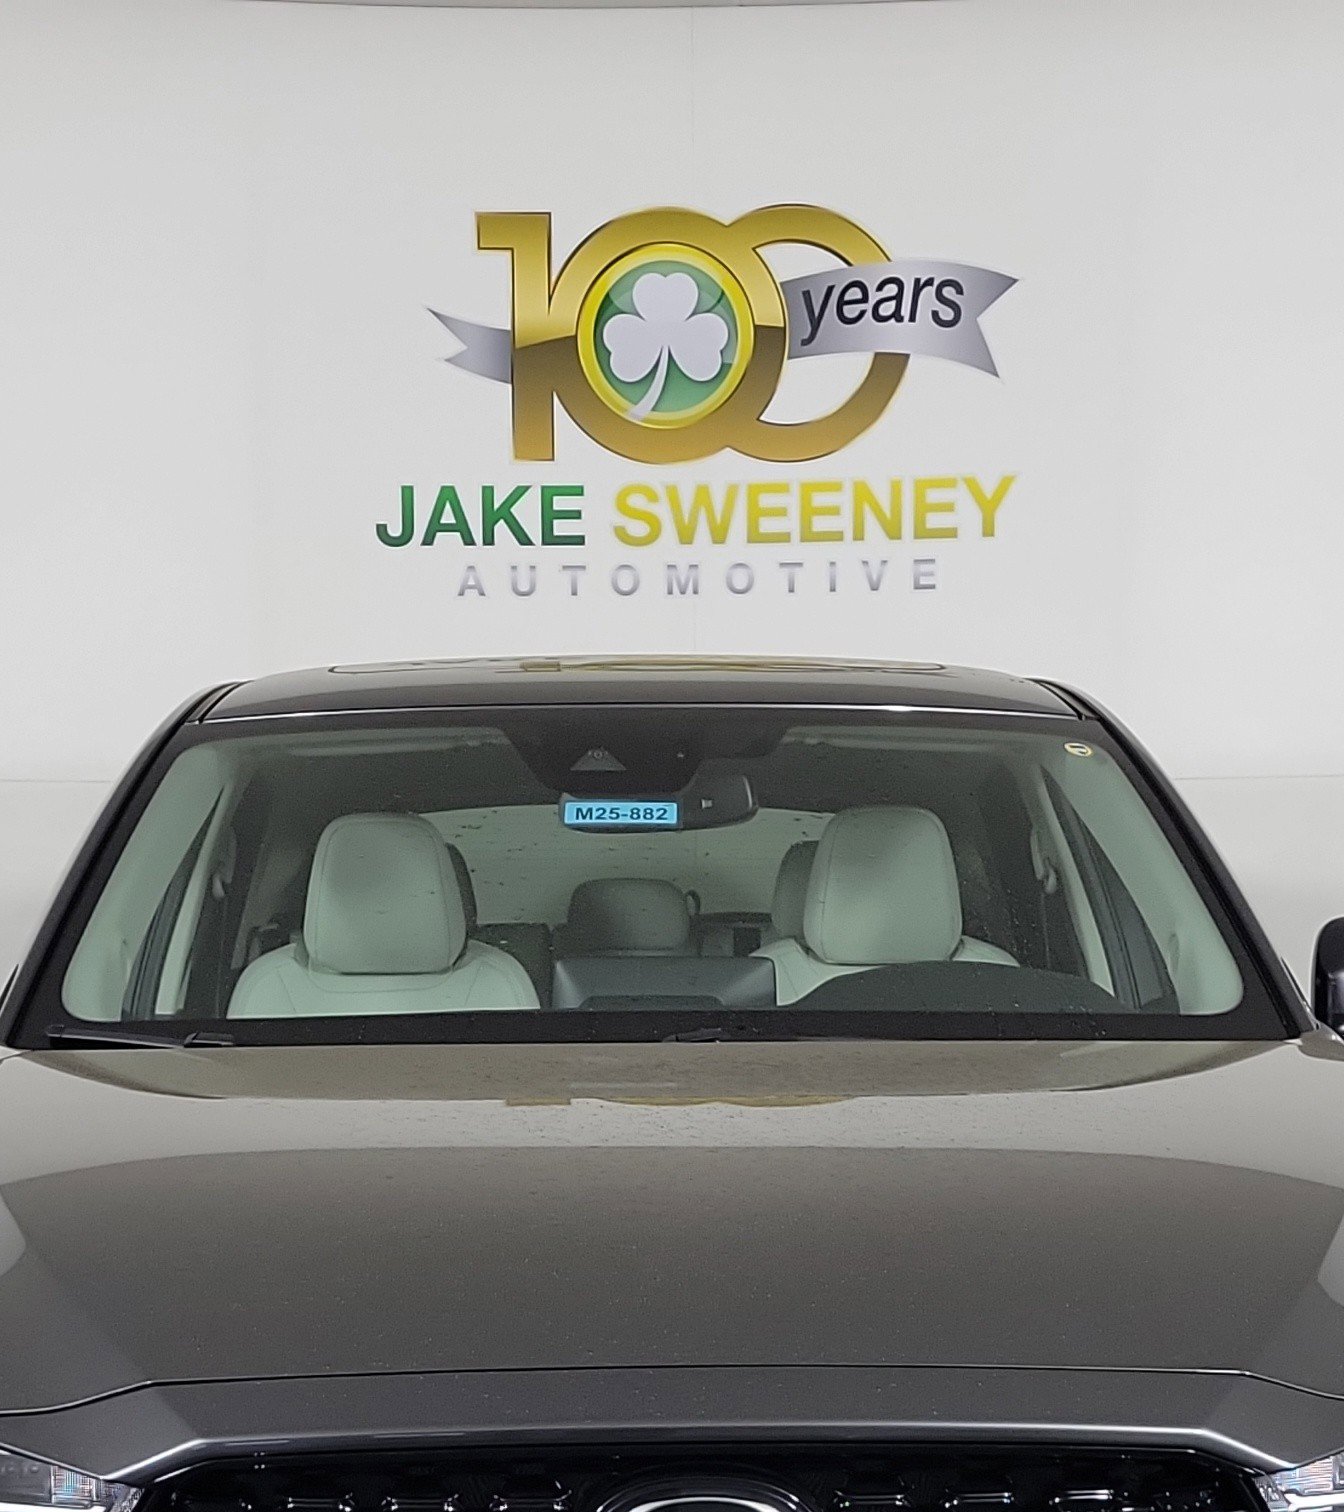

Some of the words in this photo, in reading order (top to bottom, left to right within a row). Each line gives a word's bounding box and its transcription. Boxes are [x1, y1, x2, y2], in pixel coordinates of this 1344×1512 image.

[474, 204, 912, 464] 100
[798, 273, 965, 346] years
[375, 485, 586, 547] JAKE
[613, 475, 1017, 547] SWEENEY
[457, 558, 938, 597] AUTOMOTIVE
[574, 806, 669, 821] M25-882
